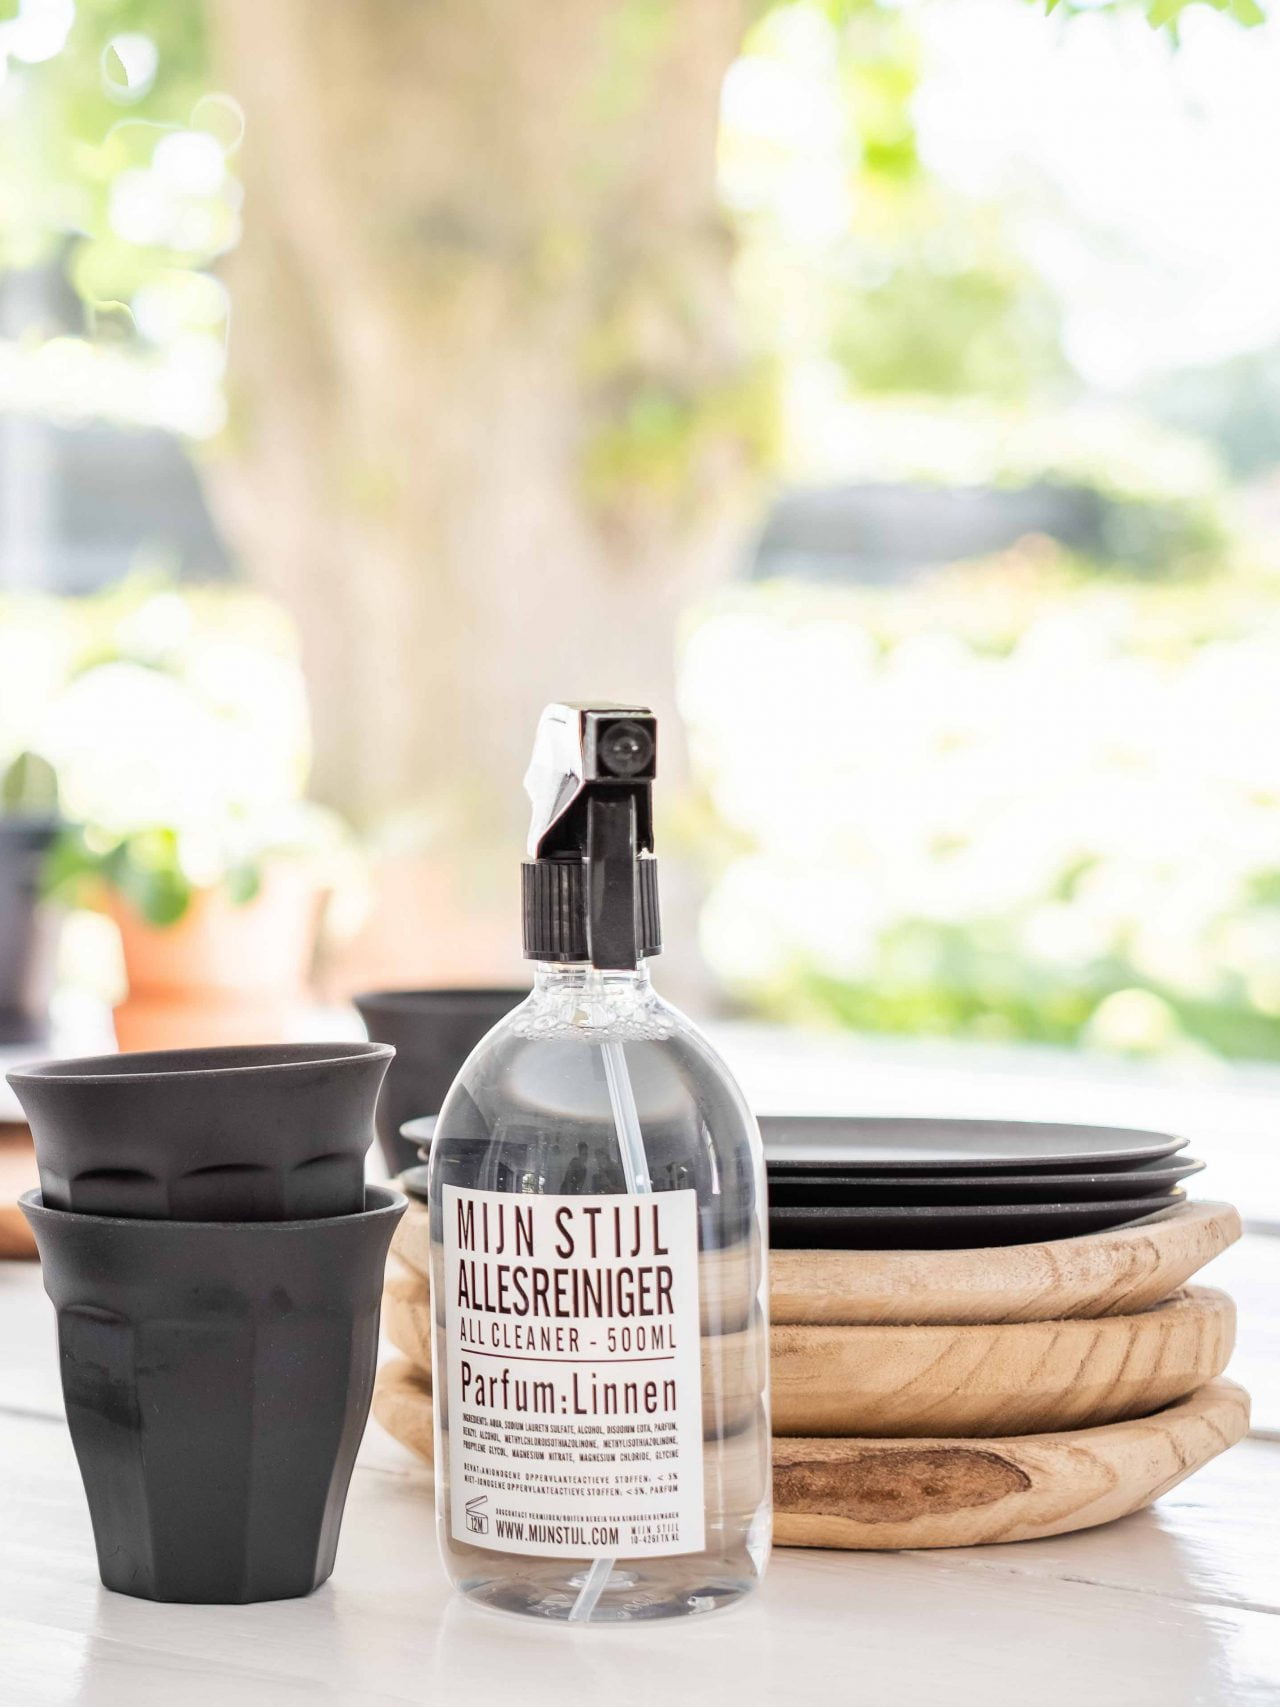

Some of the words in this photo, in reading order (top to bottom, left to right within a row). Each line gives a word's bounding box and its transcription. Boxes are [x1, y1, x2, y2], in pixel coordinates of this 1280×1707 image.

[457, 1198, 534, 1257] MIJN
[554, 1204, 669, 1259] STIJL
[457, 1259, 674, 1318] ALLESREINIGER
[460, 1317, 485, 1345] ALL
[491, 1322, 579, 1352] CLEANER
[607, 1324, 677, 1352] 500ML
[480, 1430, 502, 1442] ALCOHOL,
[504, 1420, 524, 1431] SODIUM
[550, 1424, 576, 1434] SULFATE,
[578, 1426, 604, 1435] ALCOHOL,
[654, 1422, 678, 1432] PARFUM,
[512, 1449, 544, 1460] MAGNESIUM
[548, 1452, 575, 1463] NITRATE,
[579, 1453, 616, 1462] MAGNESIUM
[470, 1517, 483, 1532] 12M
[496, 1520, 619, 1546] WWW.MIJNSTIJL.COM
